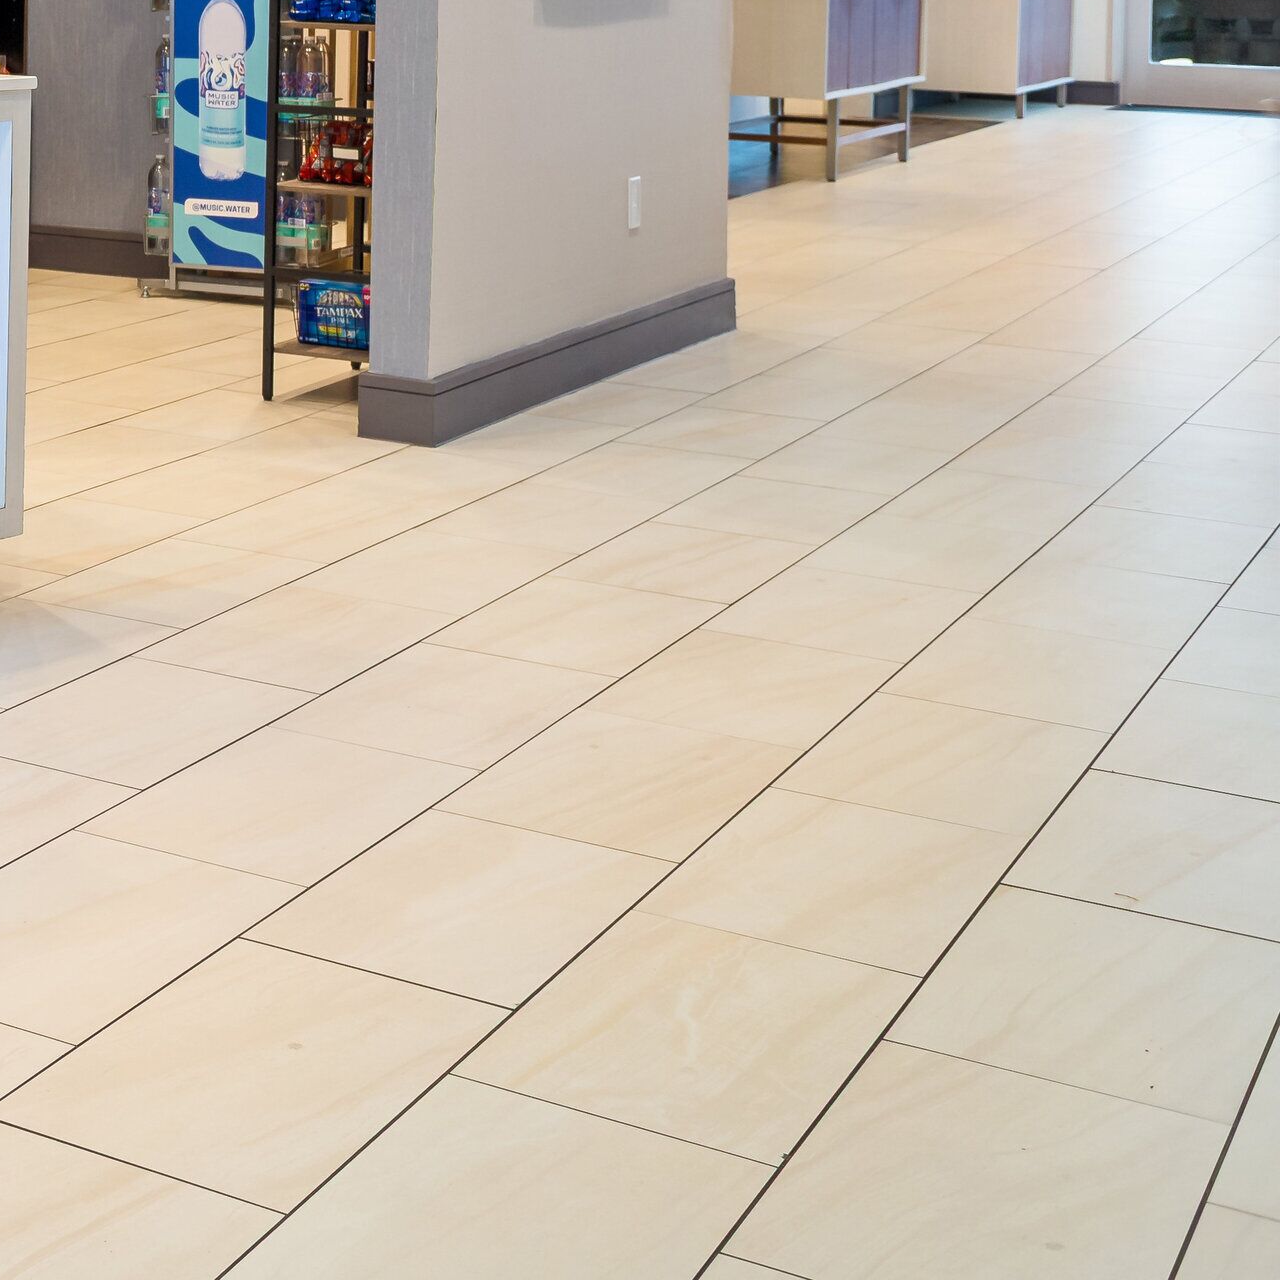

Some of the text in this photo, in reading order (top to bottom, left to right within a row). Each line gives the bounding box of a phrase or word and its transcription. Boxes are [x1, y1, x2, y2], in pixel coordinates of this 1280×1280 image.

[207, 92, 236, 100] MUSIC
[207, 99, 236, 107] WATER
[191, 202, 251, 214] @MUSIC.WATER
[316, 307, 363, 318] TAMPAX
